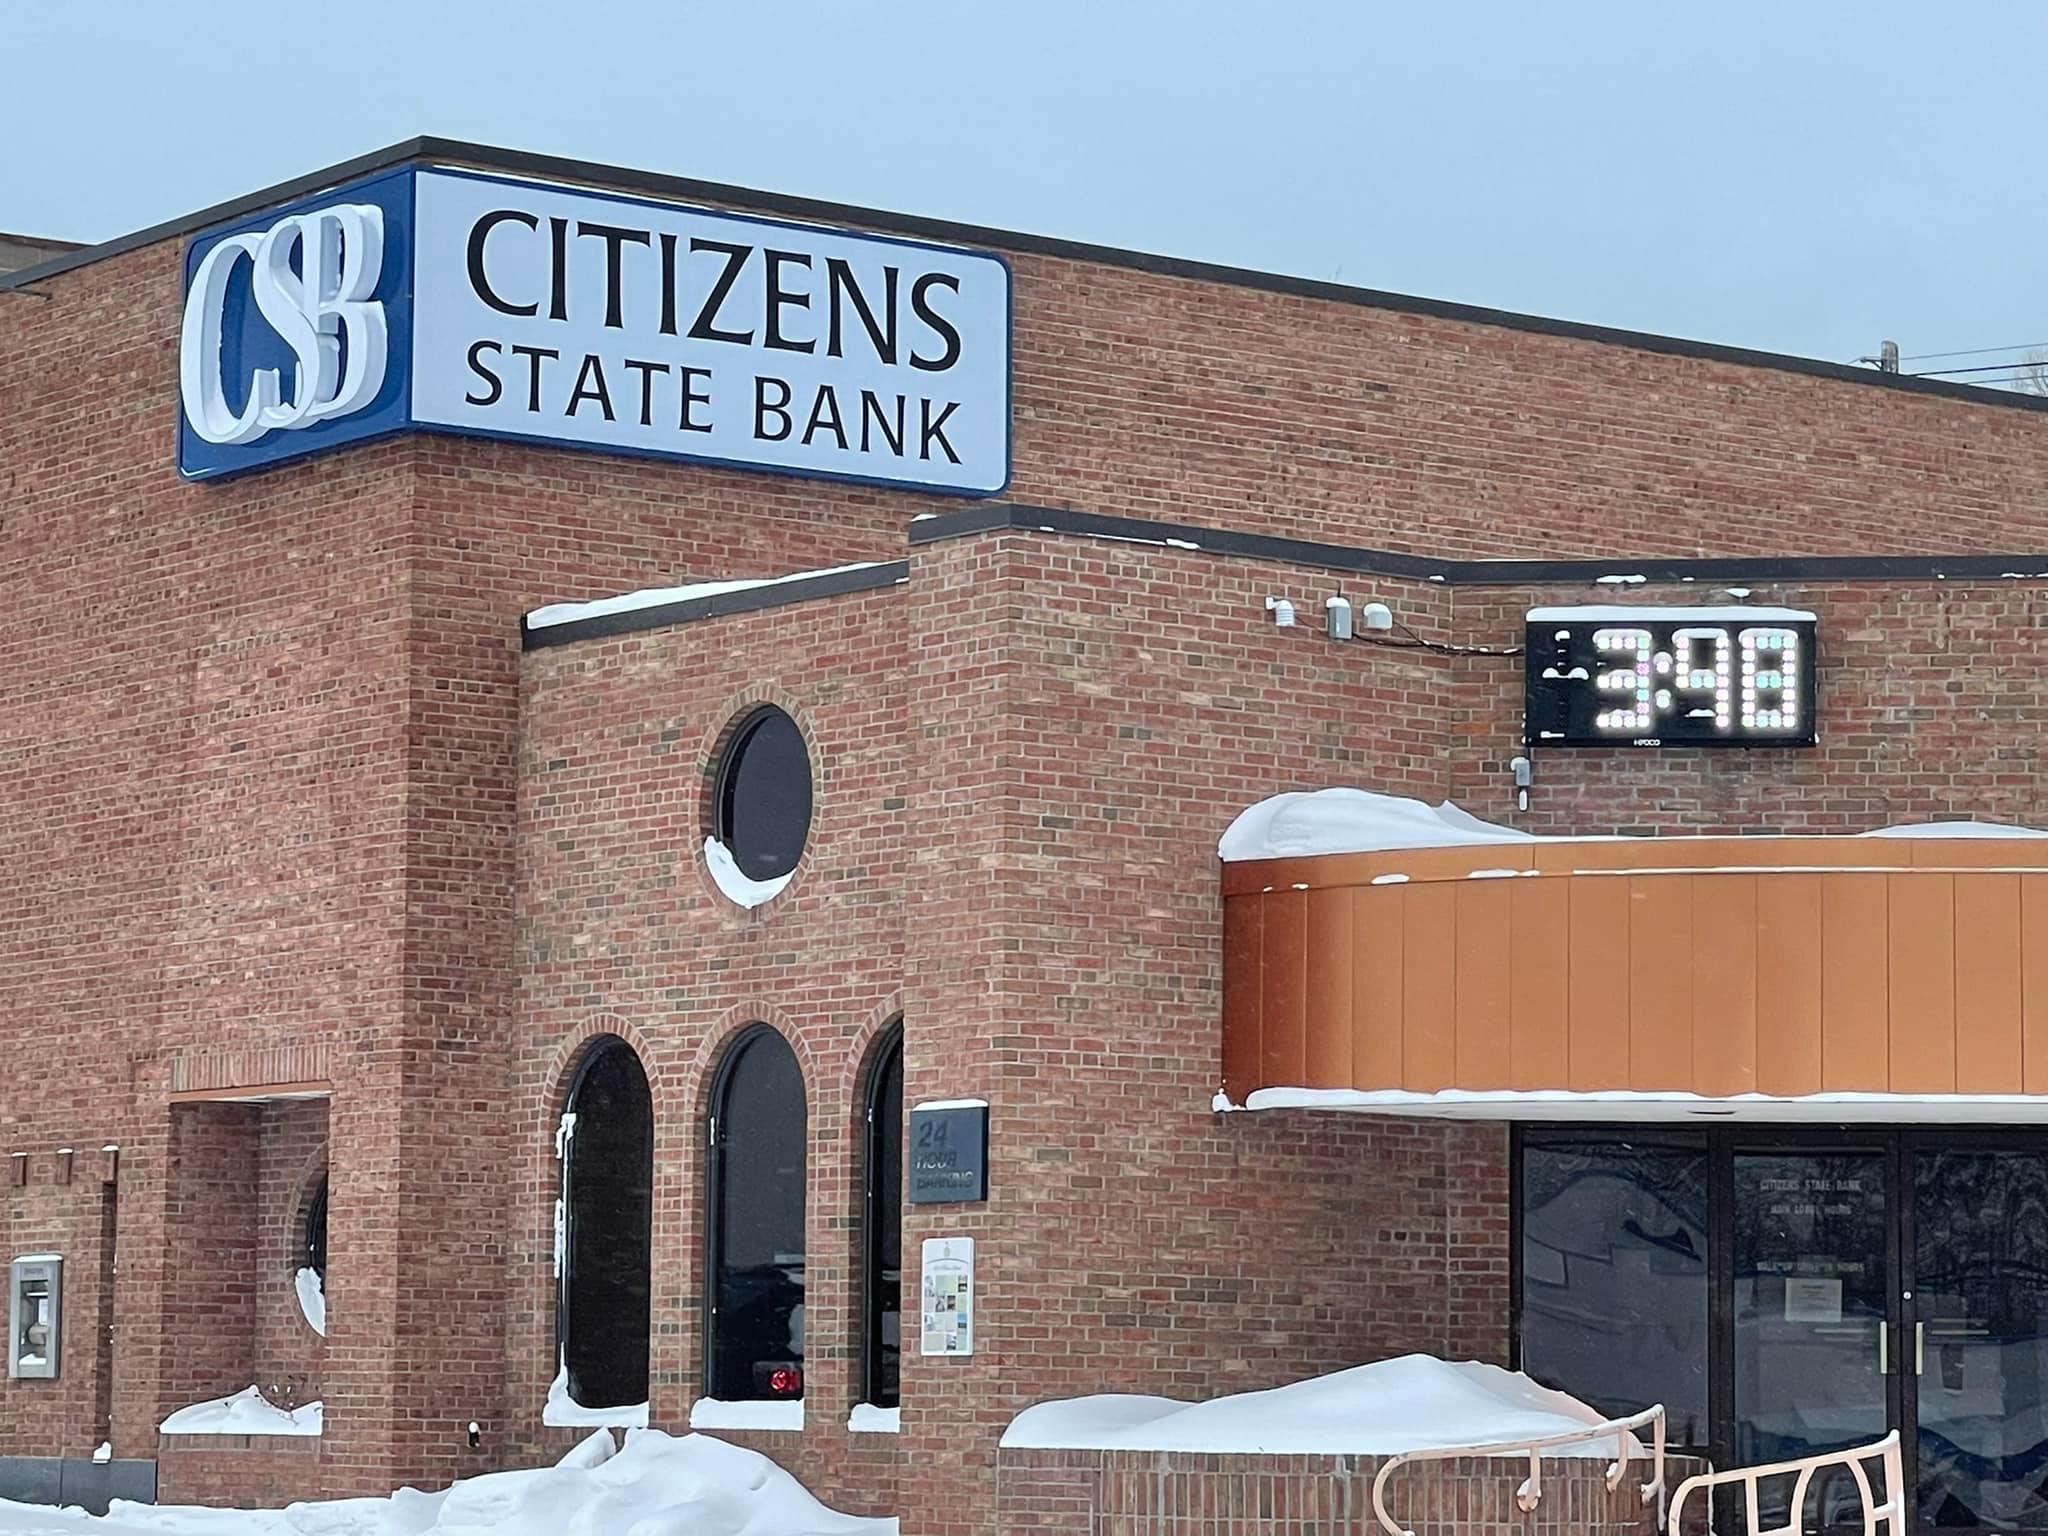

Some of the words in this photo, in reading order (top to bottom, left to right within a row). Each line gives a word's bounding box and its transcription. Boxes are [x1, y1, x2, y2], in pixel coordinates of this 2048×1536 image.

[180, 204, 388, 443] CSB
[468, 211, 960, 371] CITIZENS
[466, 341, 712, 432] STATE
[754, 376, 961, 464] BANK
[1594, 630, 1798, 728] 3:48
[918, 1119, 949, 1148] 24
